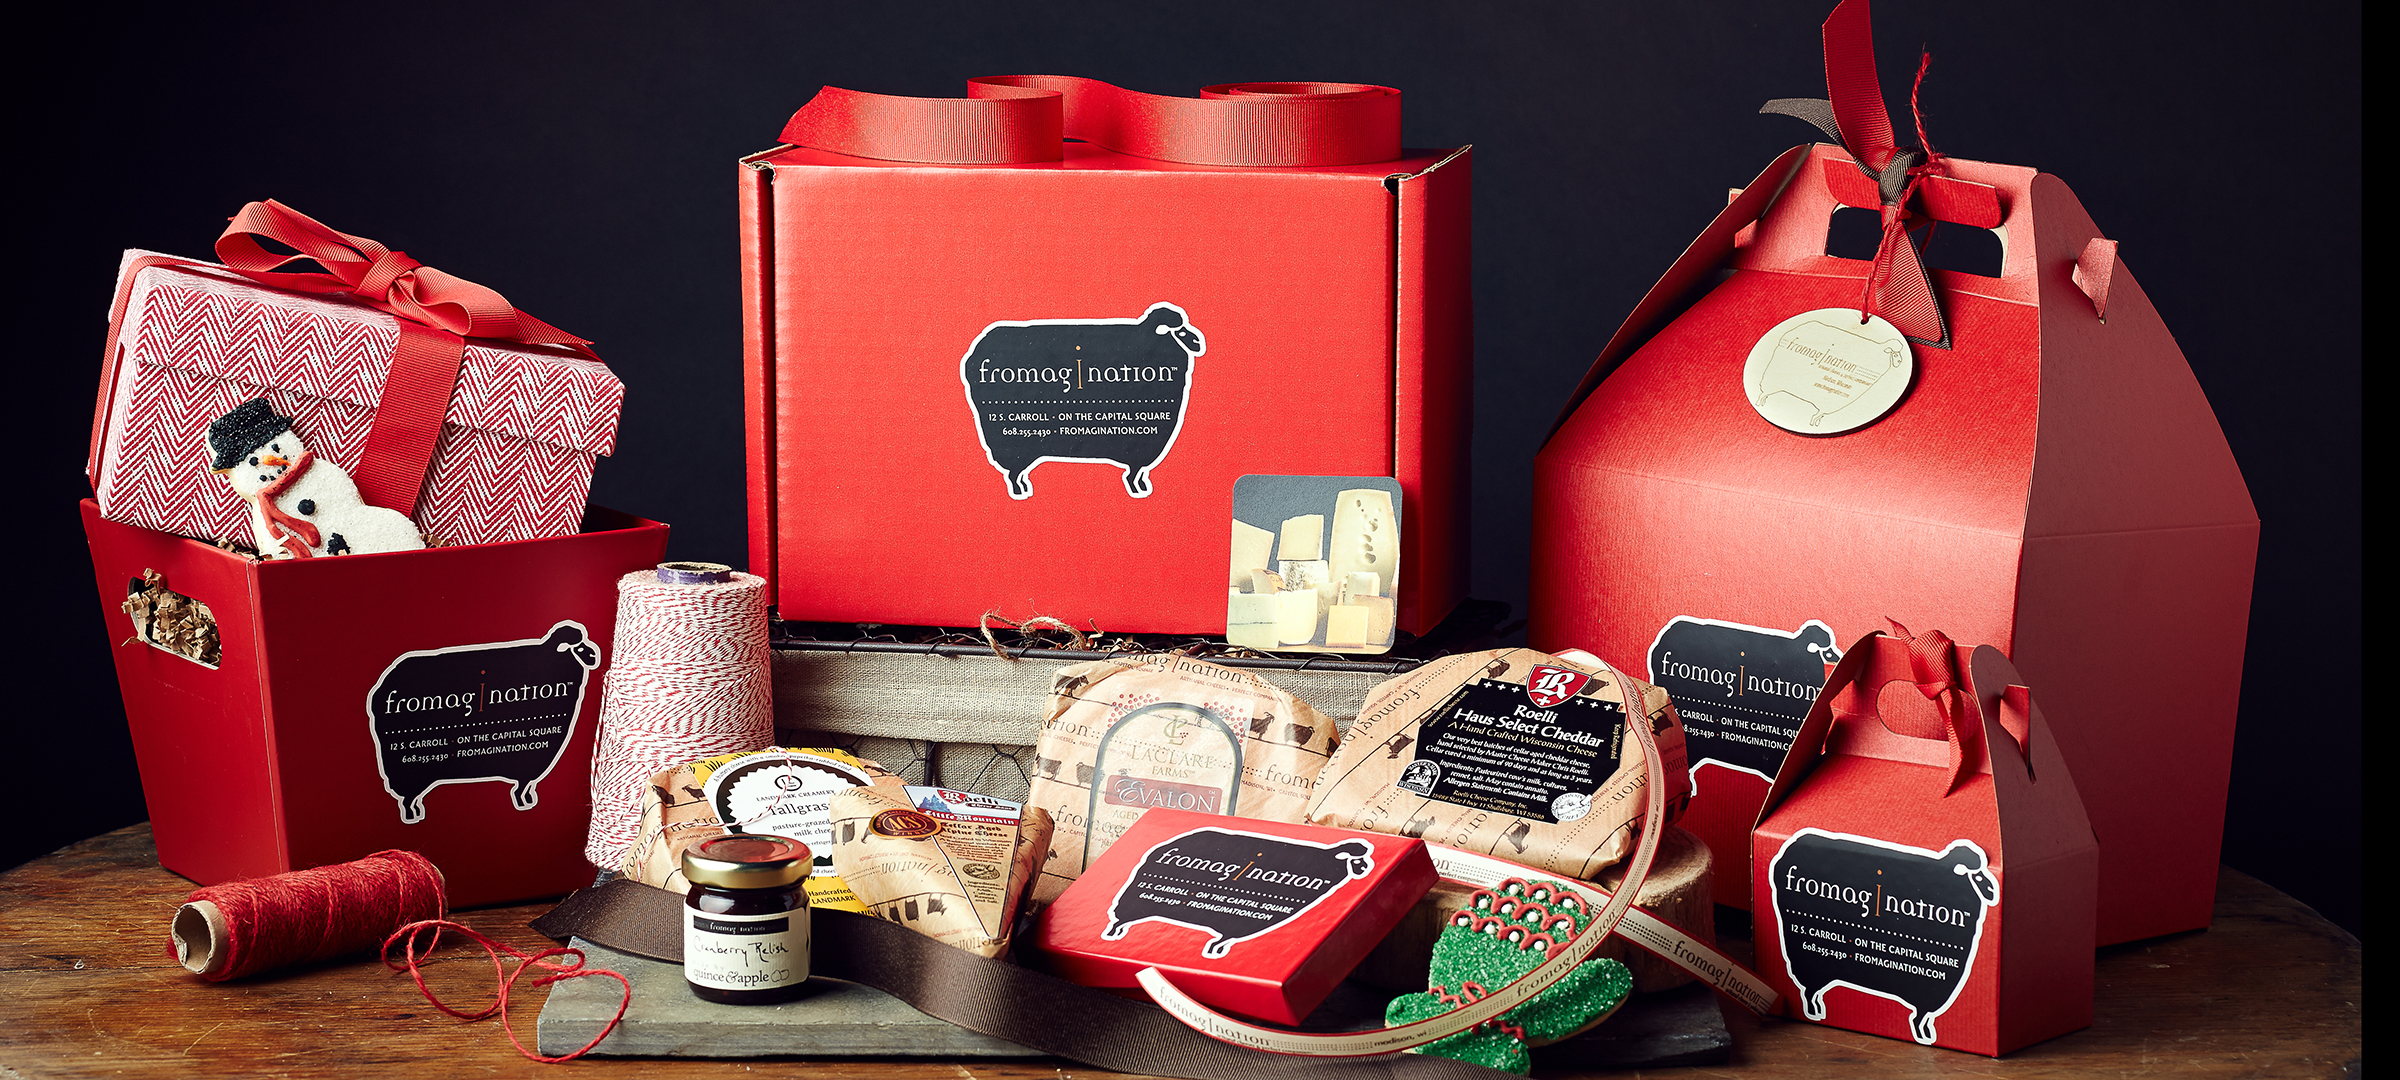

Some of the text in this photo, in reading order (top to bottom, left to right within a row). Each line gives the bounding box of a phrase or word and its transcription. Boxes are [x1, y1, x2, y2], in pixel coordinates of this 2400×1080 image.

[988, 412, 1171, 422] 12 S. CARROLL ON THE CAPITAL SQUARE
[1002, 426, 1158, 438] 608.255.2430 FROMAGINATION.COM
[1513, 704, 1559, 724] Roelli
[1681, 709, 1799, 738] CARROLL ON THE CAPITAL SQU
[1453, 707, 1605, 748] Haus Select Cheddar
[1682, 724, 1715, 738] 8.255.2430
[390, 725, 562, 751] 12 S. CARROLL ON THE CAPITAL SQUARE
[1442, 732, 1456, 741] Our
[1457, 736, 1470, 744] very
[1470, 738, 1484, 747] best
[1483, 740, 1506, 751] batches
[1513, 747, 1530, 756] cellar
[1529, 750, 1546, 759] aged
[1545, 753, 1570, 764] cheddar
[1447, 721, 1598, 758] A Hand Crafted Wisconsin Cheese
[401, 740, 549, 764] 608.255.2430 FROMAGINATION.COM
[1425, 745, 1444, 754] Cellar
[1444, 749, 1462, 758] cured
[1466, 754, 1496, 765] minimum
[1513, 762, 1527, 771] days
[1527, 766, 1541, 774] and
[1547, 769, 1562, 779] long
[1436, 738, 1454, 748] hand
[1453, 743, 1477, 753] selected
[1477, 747, 1485, 755] by
[1485, 749, 1508, 759] Master
[1507, 754, 1531, 763] Cheese
[1530, 758, 1552, 768] Maker
[1552, 763, 1569, 772] Chris
[1474, 766, 1509, 779] Pasteurized
[1442, 776, 1470, 788] Allergen
[1502, 787, 1531, 799] Contains
[1485, 776, 1501, 786] May
[1501, 779, 1524, 790] contain
[797, 789, 835, 798] CREAMERY
[765, 802, 831, 816] Tallgras
[955, 813, 1015, 825] Mountain
[772, 818, 831, 832] pasture-grazed
[793, 827, 831, 837] milk chee
[888, 816, 921, 831] ACS
[807, 888, 852, 897] Handcrafted
[811, 895, 857, 905] LANDMARK
[1153, 884, 1190, 896] CARROLL
[1195, 891, 1209, 900] ON
[1209, 893, 1227, 903] THE
[1226, 896, 1260, 909] CAPITAL
[1260, 902, 1294, 914] SQUARE
[1186, 900, 1274, 921] FROMAGINATION.COM
[693, 935, 790, 968] Cranberry Relish
[1791, 924, 1960, 968] 12 S. CARROLL ON THE CAPITAL SQUARE
[1802, 942, 1946, 981] 608.255.2430 FROMAGINATION.COM
[1373, 1029, 1428, 1047] madison, wi
